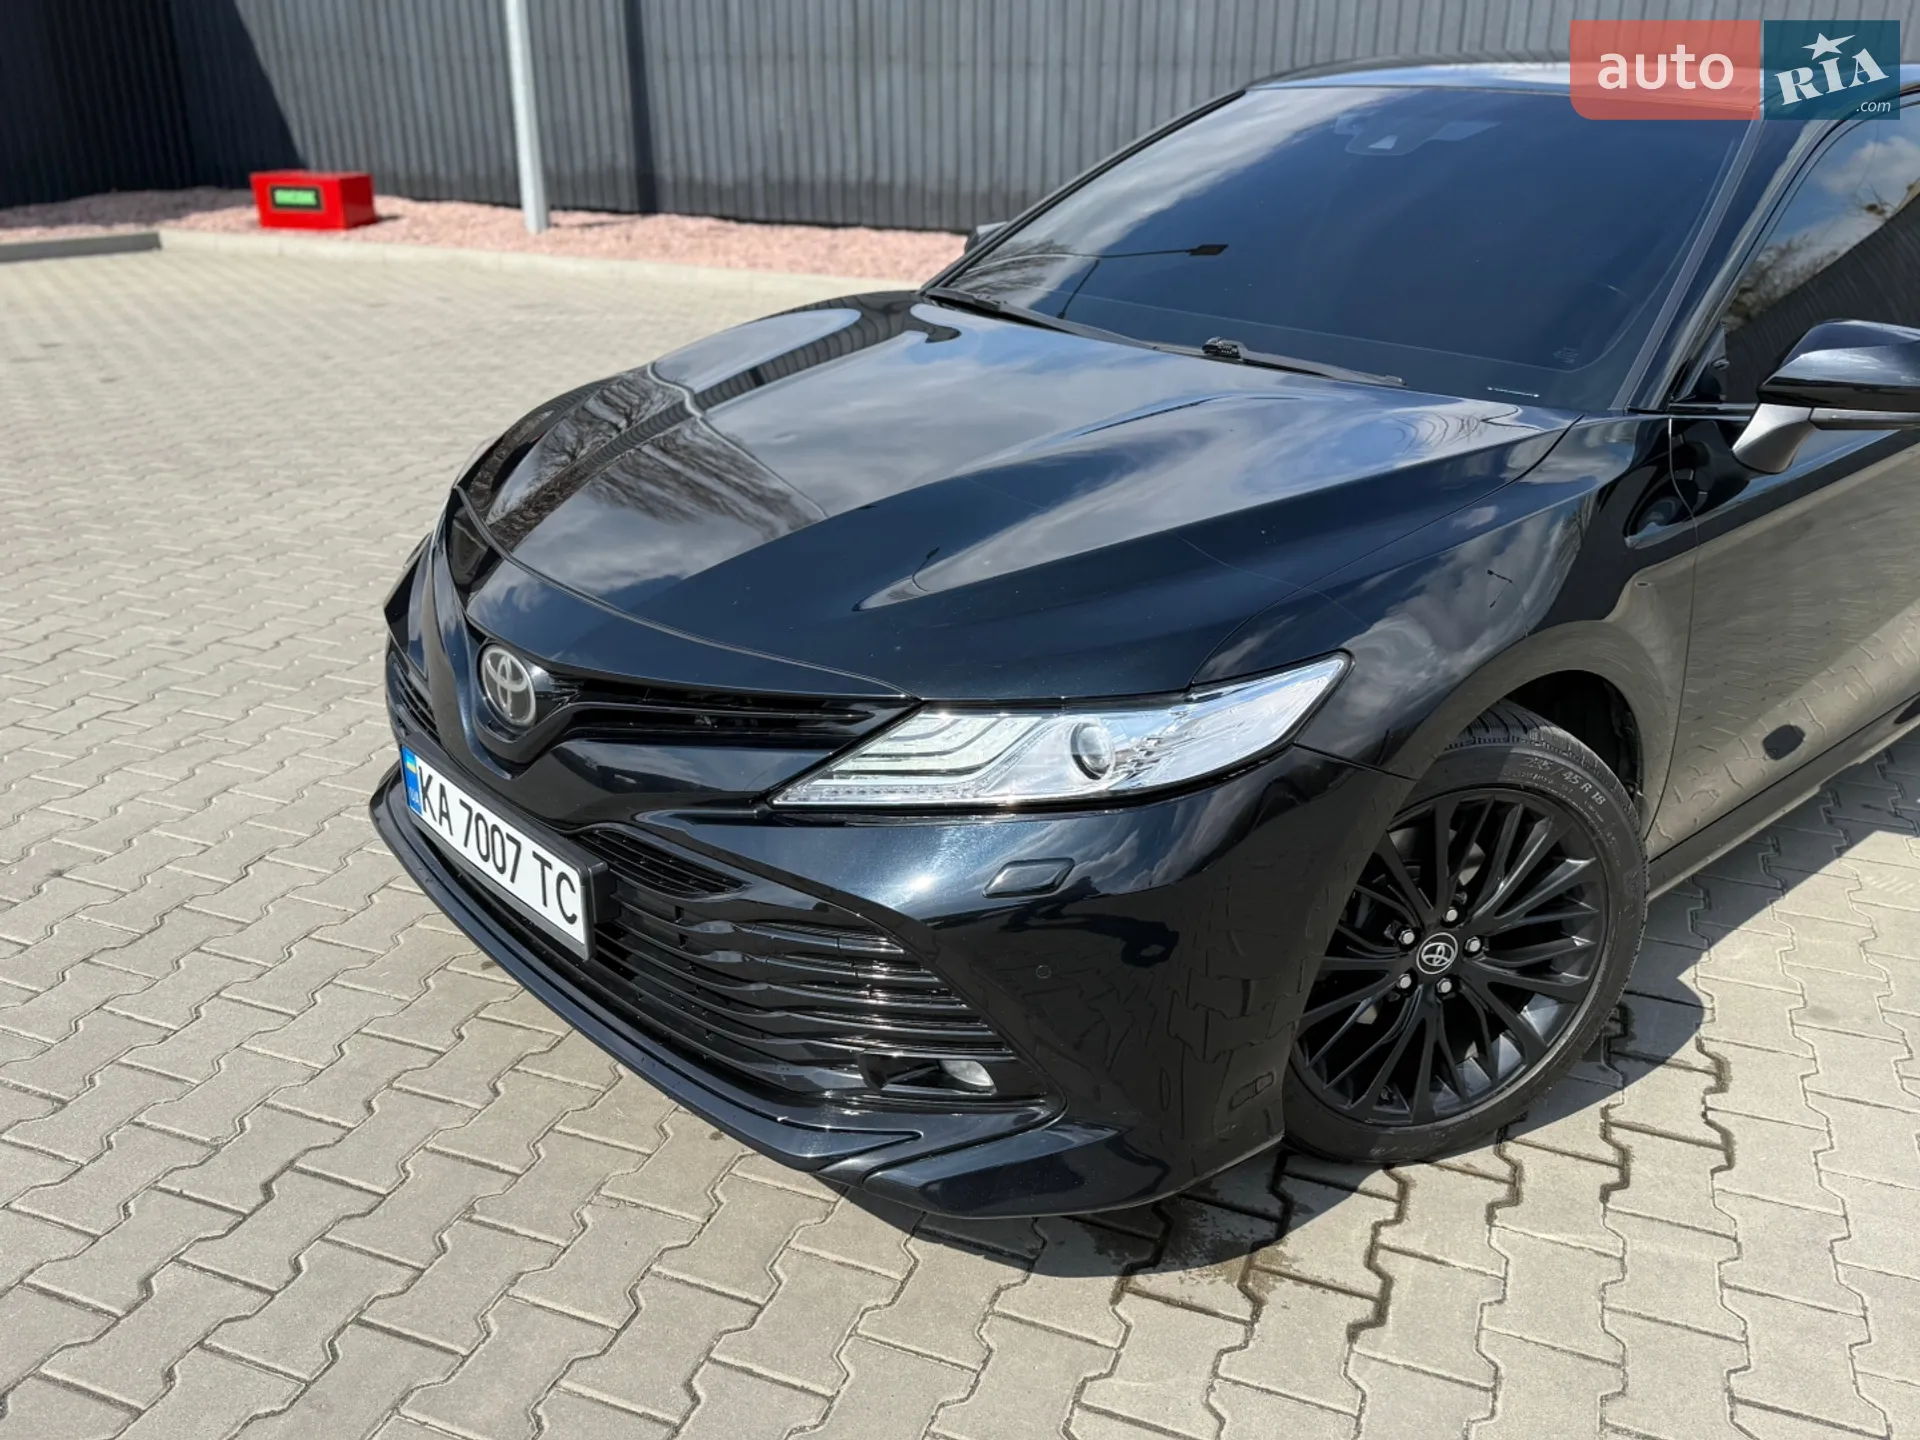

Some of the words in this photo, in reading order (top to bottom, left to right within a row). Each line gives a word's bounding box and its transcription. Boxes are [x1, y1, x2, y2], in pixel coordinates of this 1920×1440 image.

[418, 765, 454, 837] KA
[459, 798, 522, 884] 7007
[532, 850, 578, 925] TC
